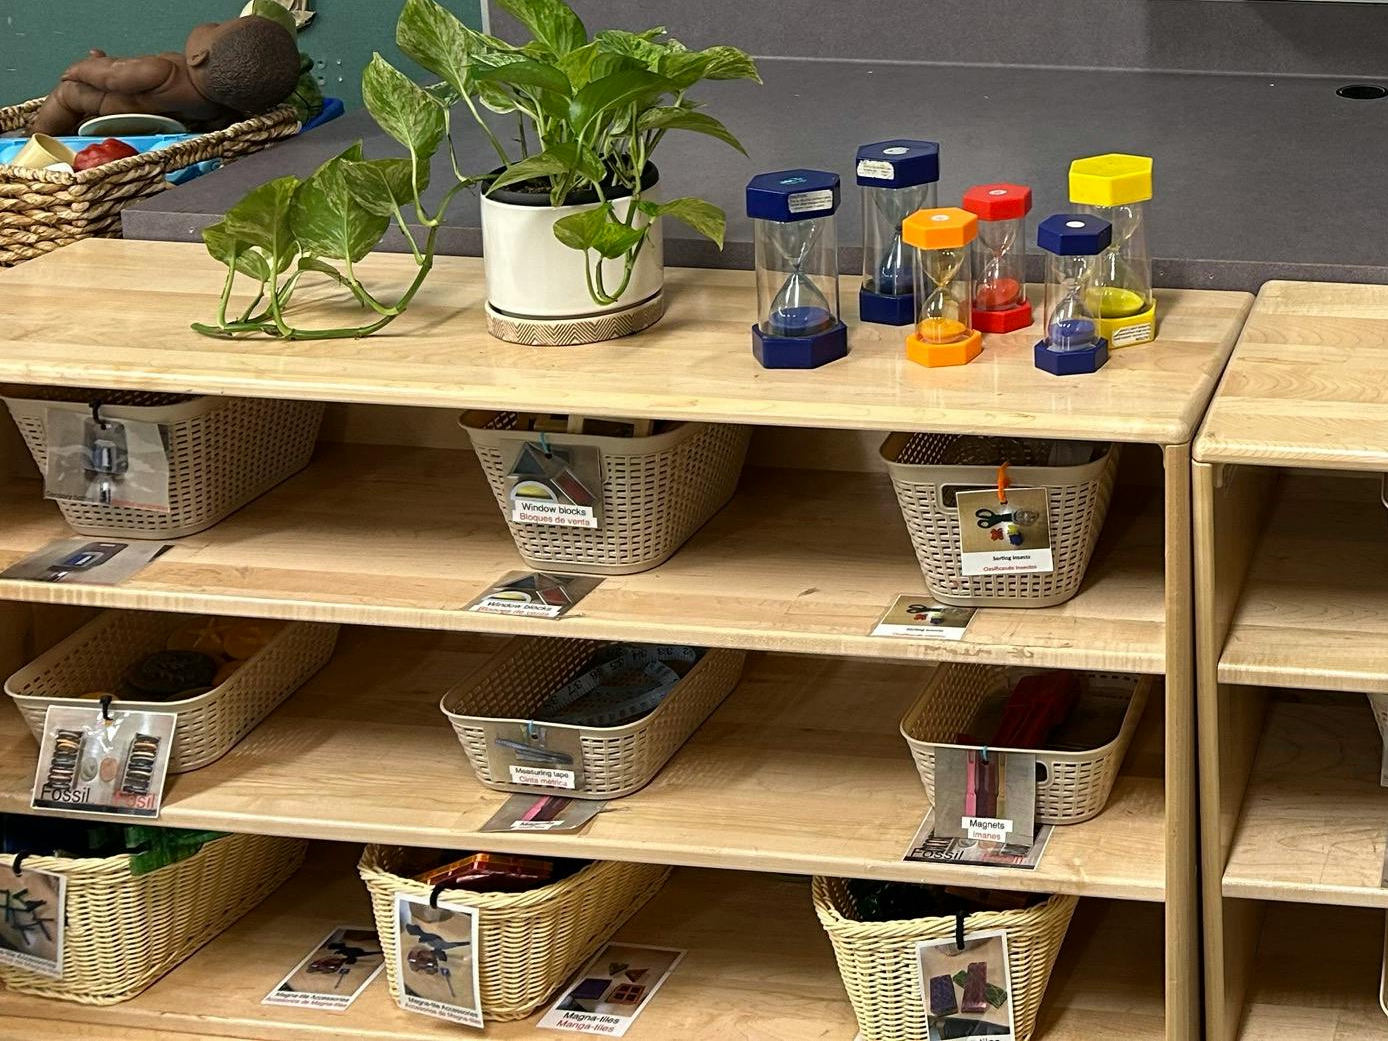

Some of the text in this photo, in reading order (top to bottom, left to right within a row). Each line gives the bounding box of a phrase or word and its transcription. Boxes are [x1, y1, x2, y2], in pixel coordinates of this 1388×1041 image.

[522, 503, 588, 515] Window blocks
[519, 513, 590, 527] Bloques de venta
[515, 768, 552, 777] Measuring
[41, 786, 90, 803] Fossil
[970, 819, 1004, 829] Magnets
[911, 848, 964, 860] Fossil
[563, 1012, 620, 1024] Magna-tiles
[557, 1020, 614, 1032] Manga-tiles
